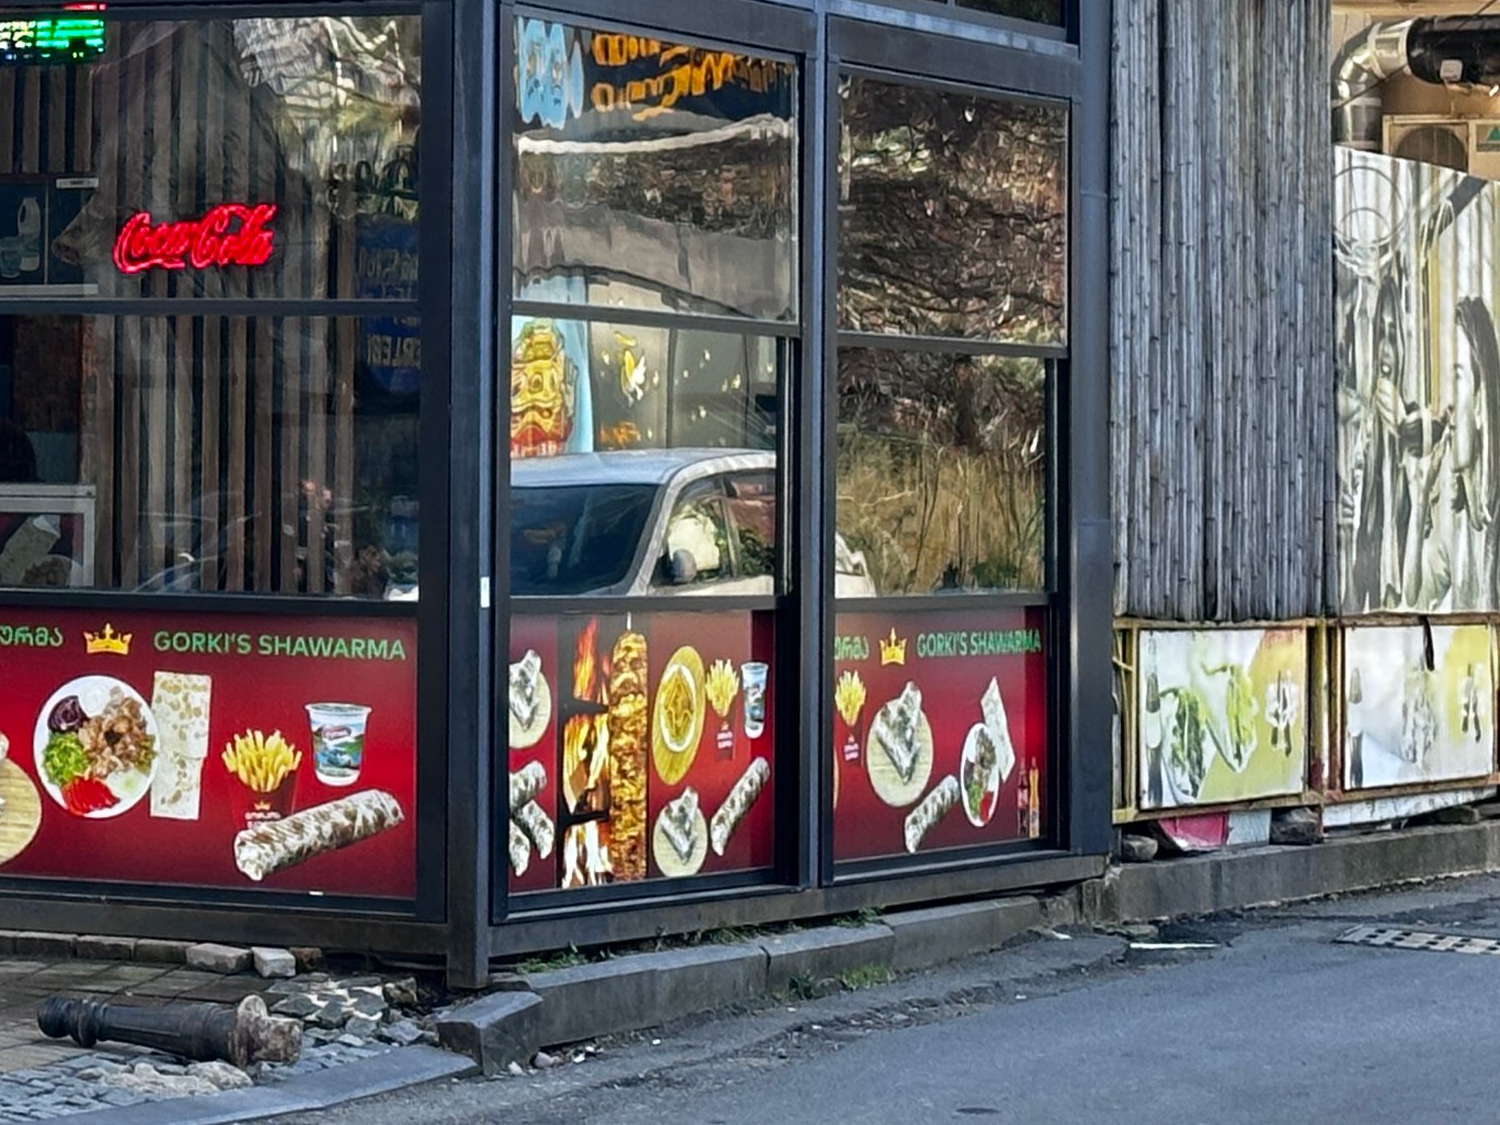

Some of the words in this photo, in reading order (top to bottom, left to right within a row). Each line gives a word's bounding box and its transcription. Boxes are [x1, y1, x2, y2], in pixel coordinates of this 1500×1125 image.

[112, 204, 278, 274] Coca-Cola
[153, 630, 252, 654] GORKI'S
[257, 633, 407, 661] SHAWARMA
[916, 631, 968, 658] GORKI'S
[970, 629, 1042, 655] SHAWARMA
